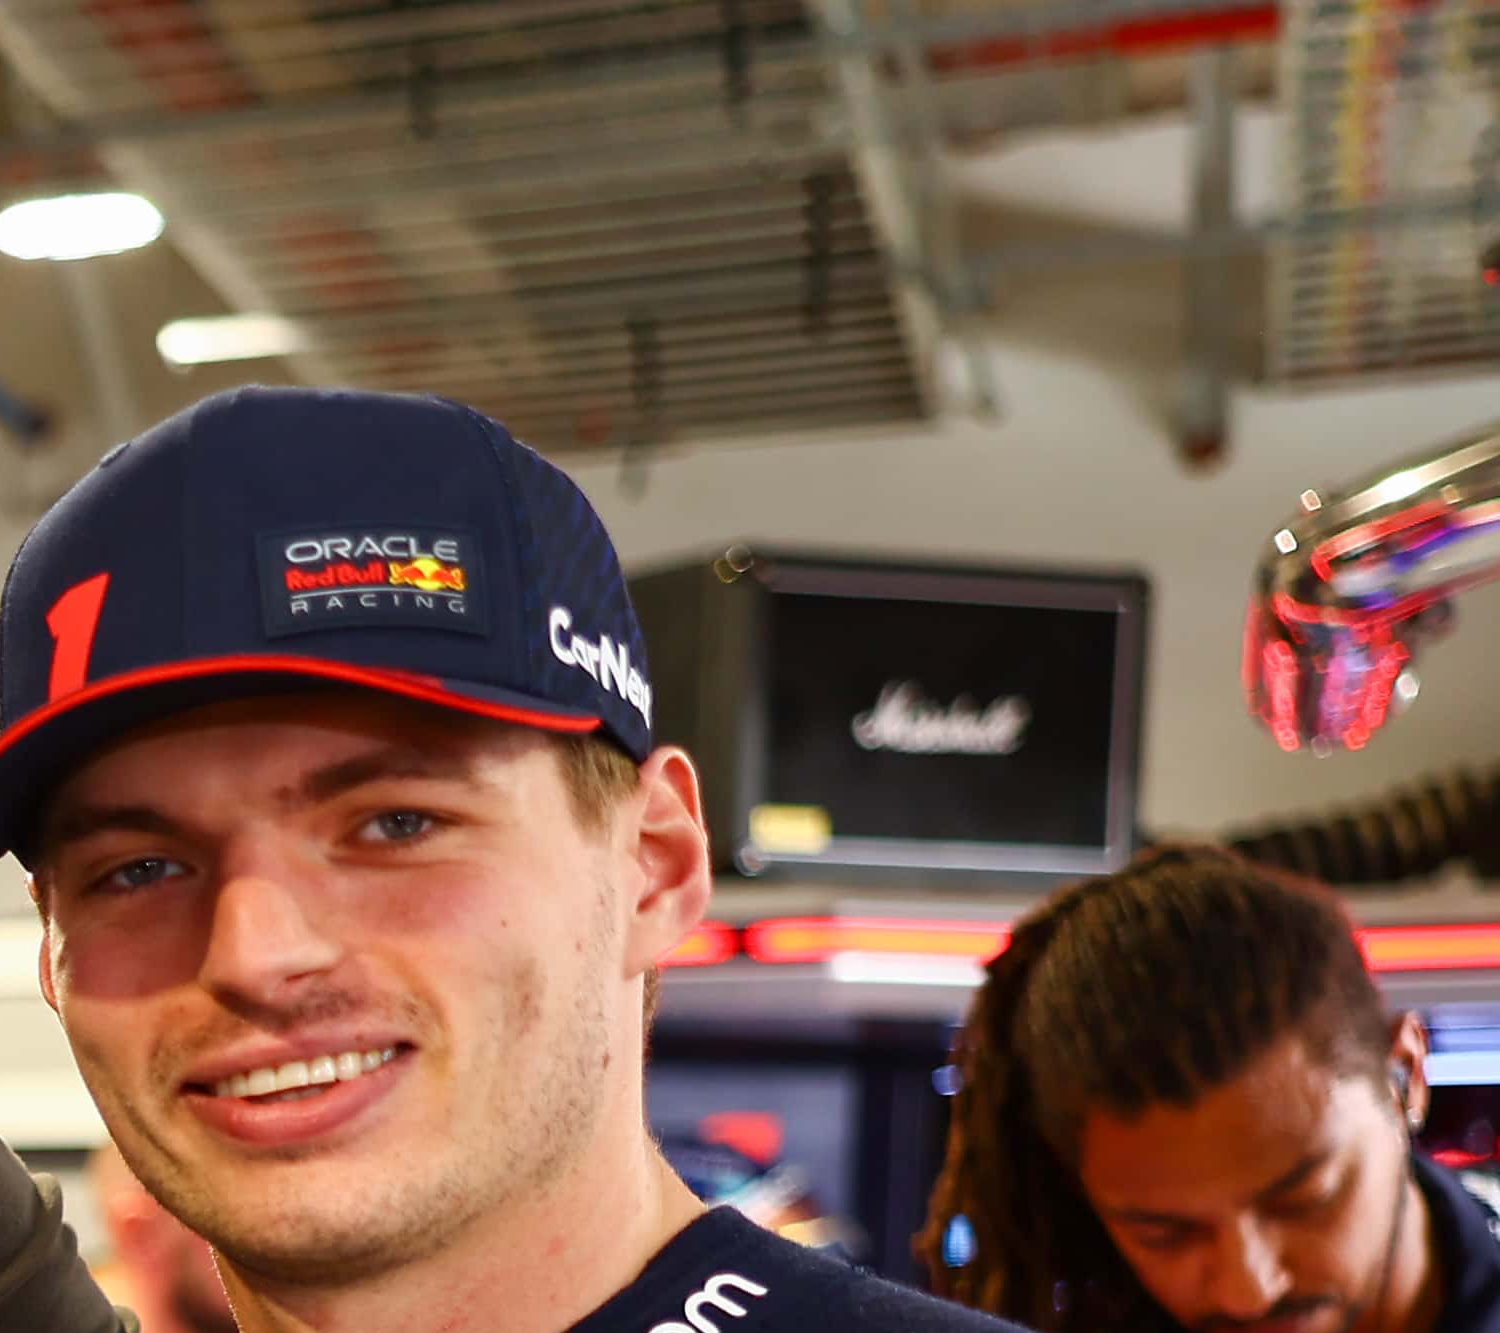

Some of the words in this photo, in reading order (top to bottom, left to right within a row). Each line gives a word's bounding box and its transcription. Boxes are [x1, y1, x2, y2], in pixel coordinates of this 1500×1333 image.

[285, 537, 458, 562] ORACLE
[286, 565, 332, 591] Red
[333, 563, 386, 588] Bull
[293, 594, 466, 616] RACING
[45, 573, 110, 702] 1
